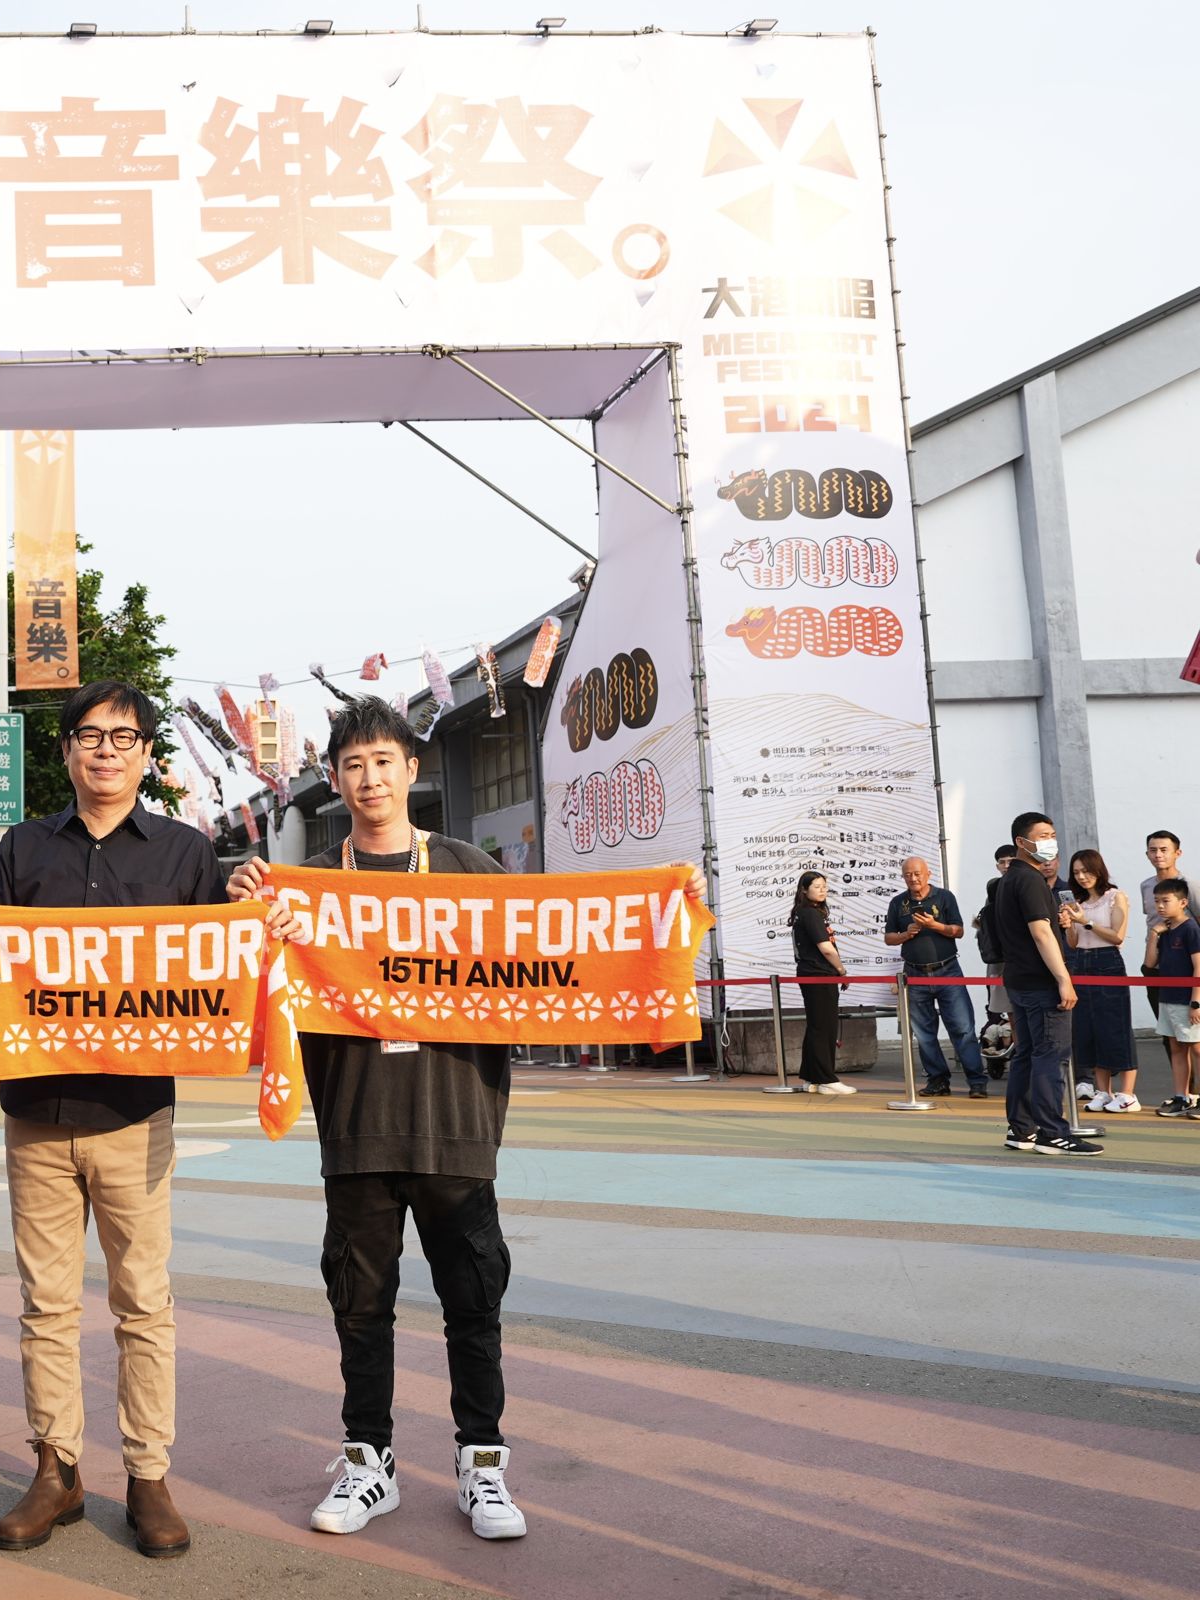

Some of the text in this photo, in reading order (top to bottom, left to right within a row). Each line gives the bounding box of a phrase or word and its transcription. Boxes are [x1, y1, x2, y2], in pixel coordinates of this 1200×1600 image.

[702, 277, 876, 319] 大港唱
[702, 332, 877, 356] MEGART
[717, 360, 874, 383] FESTAL
[723, 395, 872, 433] 2024
[10, 717, 20, 728] E.
[735, 864, 773, 872] Neogence
[798, 861, 818, 869] Joie
[858, 860, 877, 869] yoxi
[155, 917, 264, 982] FOR
[378, 956, 579, 989] 15TH ANNIV.
[24, 988, 230, 1019] 15TH ANNIV.
